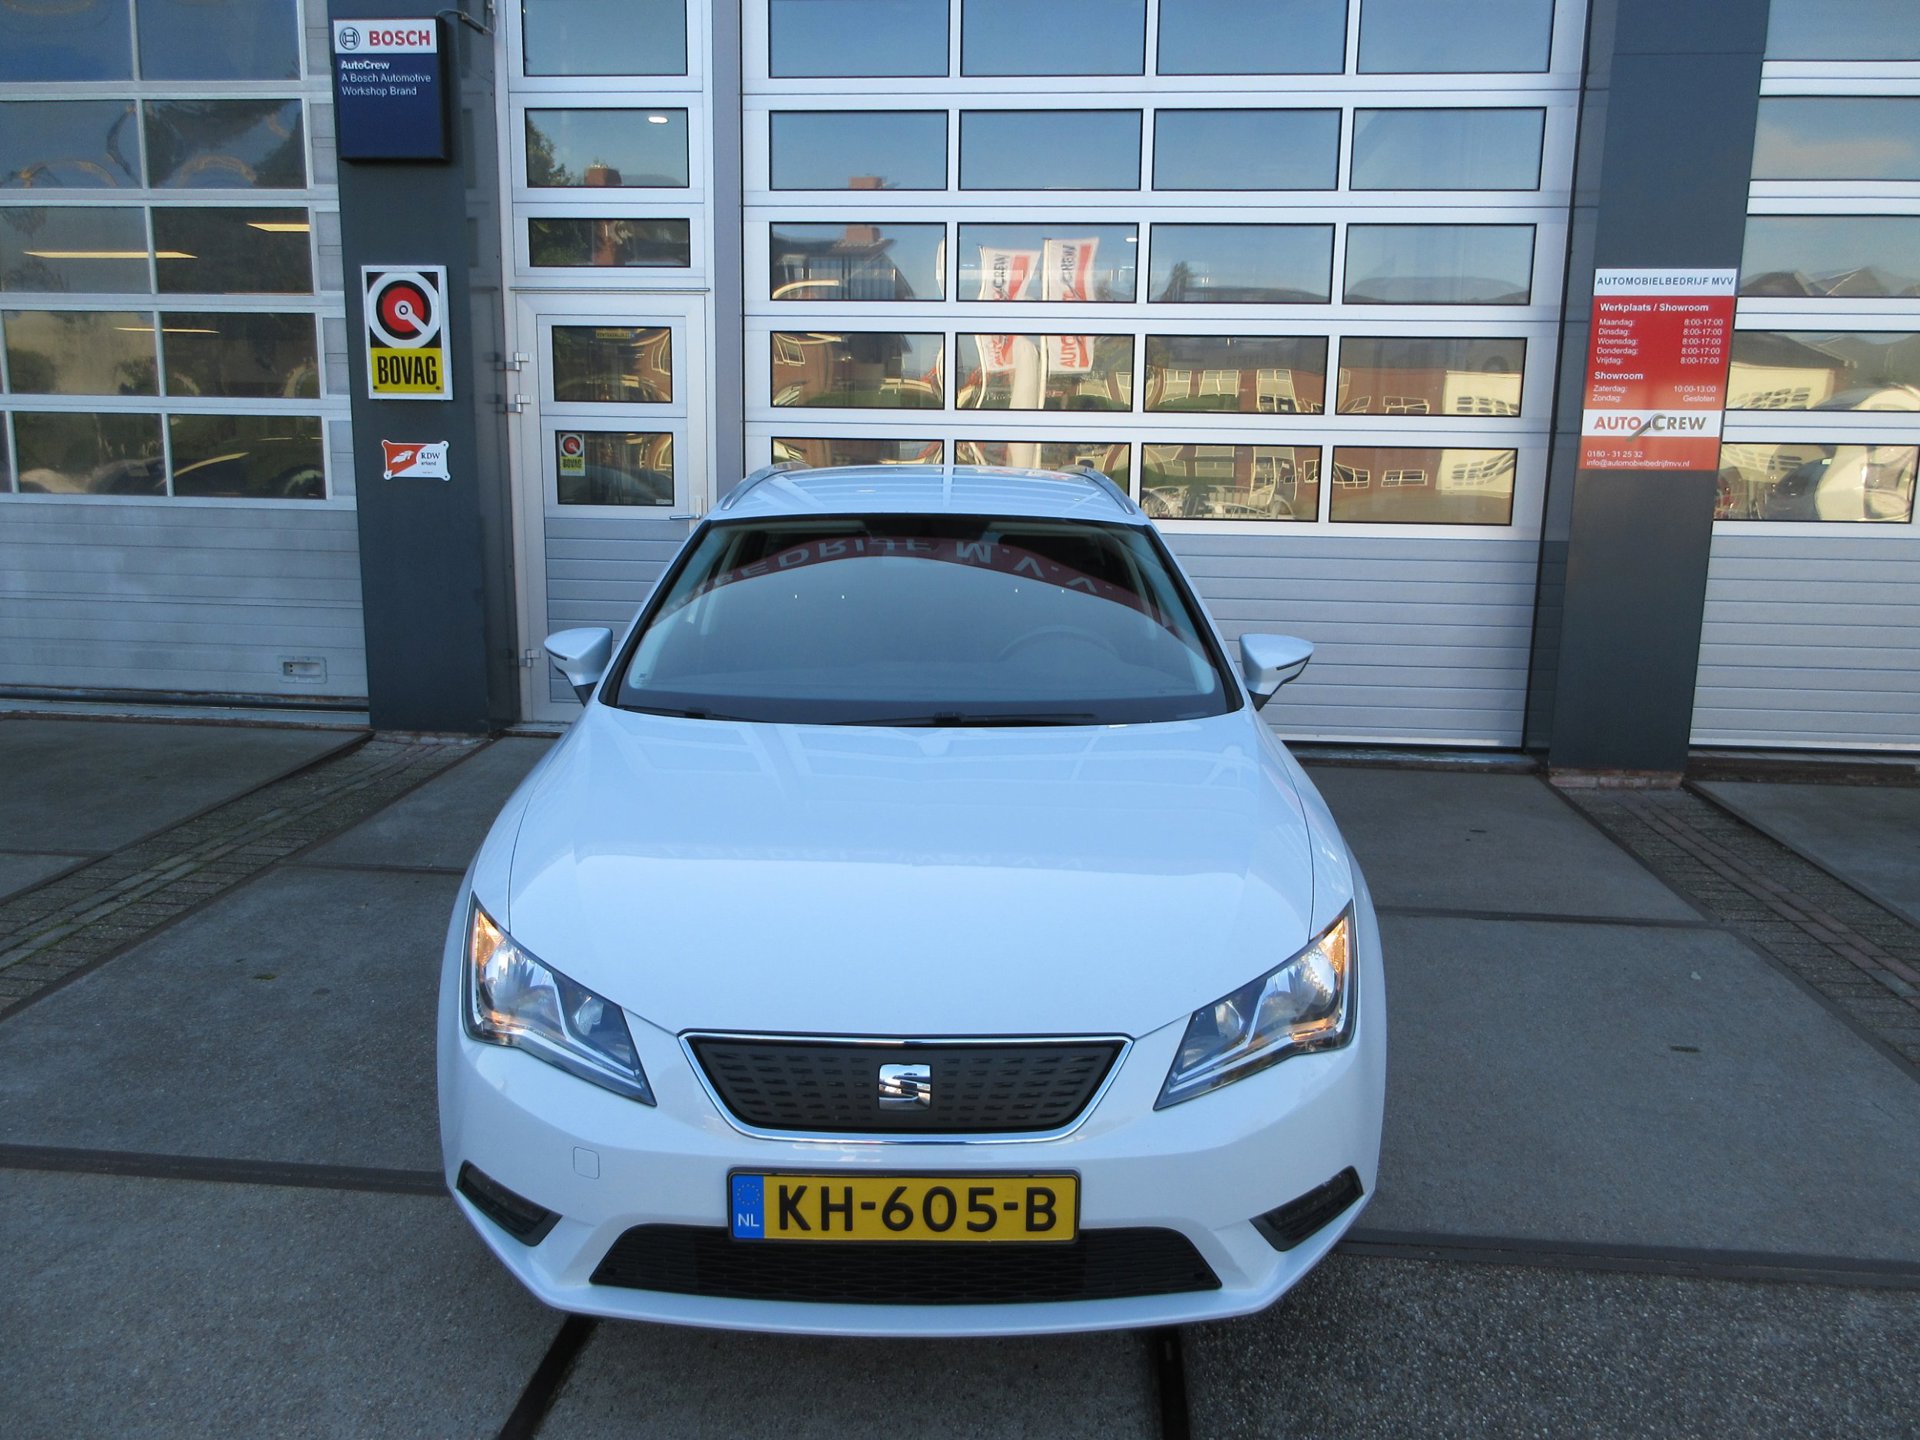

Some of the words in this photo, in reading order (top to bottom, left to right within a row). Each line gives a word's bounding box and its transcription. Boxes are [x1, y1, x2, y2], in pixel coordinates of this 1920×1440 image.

[369, 30, 431, 46] BOSCH
[341, 60, 390, 70] AutoCrew
[341, 74, 349, 82] A
[350, 73, 379, 82] Bosch
[380, 73, 431, 82] Automotive
[341, 87, 387, 97] Workshop
[389, 87, 417, 96] Brand
[1597, 276, 1709, 286] AUTOMOBIELBEDRIJF
[1711, 276, 1734, 285] MVV
[1600, 303, 1651, 312] Werkplaats
[1659, 303, 1709, 311] Showroom
[1683, 318, 1723, 326] 8:00-17:00
[1682, 337, 1721, 345] 8:00-17:00
[377, 355, 437, 385] BOVAG
[1594, 371, 1644, 380] Showroom
[1682, 394, 1715, 402] Gesloten
[1594, 416, 1642, 430] AUTO
[1651, 413, 1707, 431] CREW
[421, 452, 440, 460] RDW
[1587, 450, 1605, 458] 0180
[1611, 450, 1620, 458] 31
[1622, 450, 1632, 458] 25
[1634, 450, 1643, 458] 32
[1586, 459, 1689, 468] info@automobielbedrijfmvv.nl
[778, 1185, 1058, 1232] KH-605-B
[737, 1213, 760, 1228] NL
